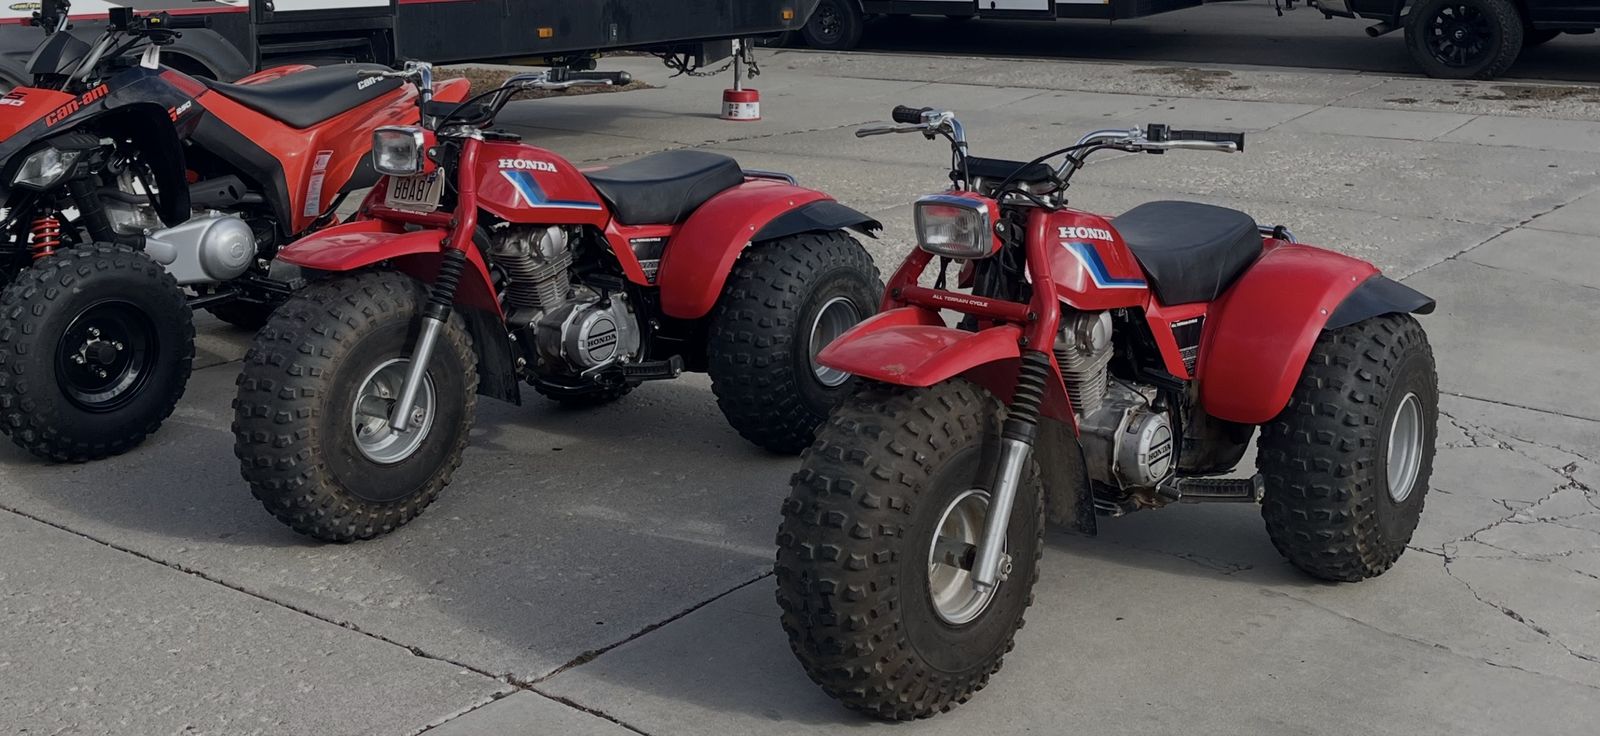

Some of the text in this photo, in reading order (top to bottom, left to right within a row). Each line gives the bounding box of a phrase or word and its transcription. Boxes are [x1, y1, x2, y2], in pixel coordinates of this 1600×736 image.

[45, 84, 110, 127] can-am
[498, 159, 558, 173] HONDA
[1058, 226, 1114, 242] HONDA
[588, 333, 617, 347] HONDA
